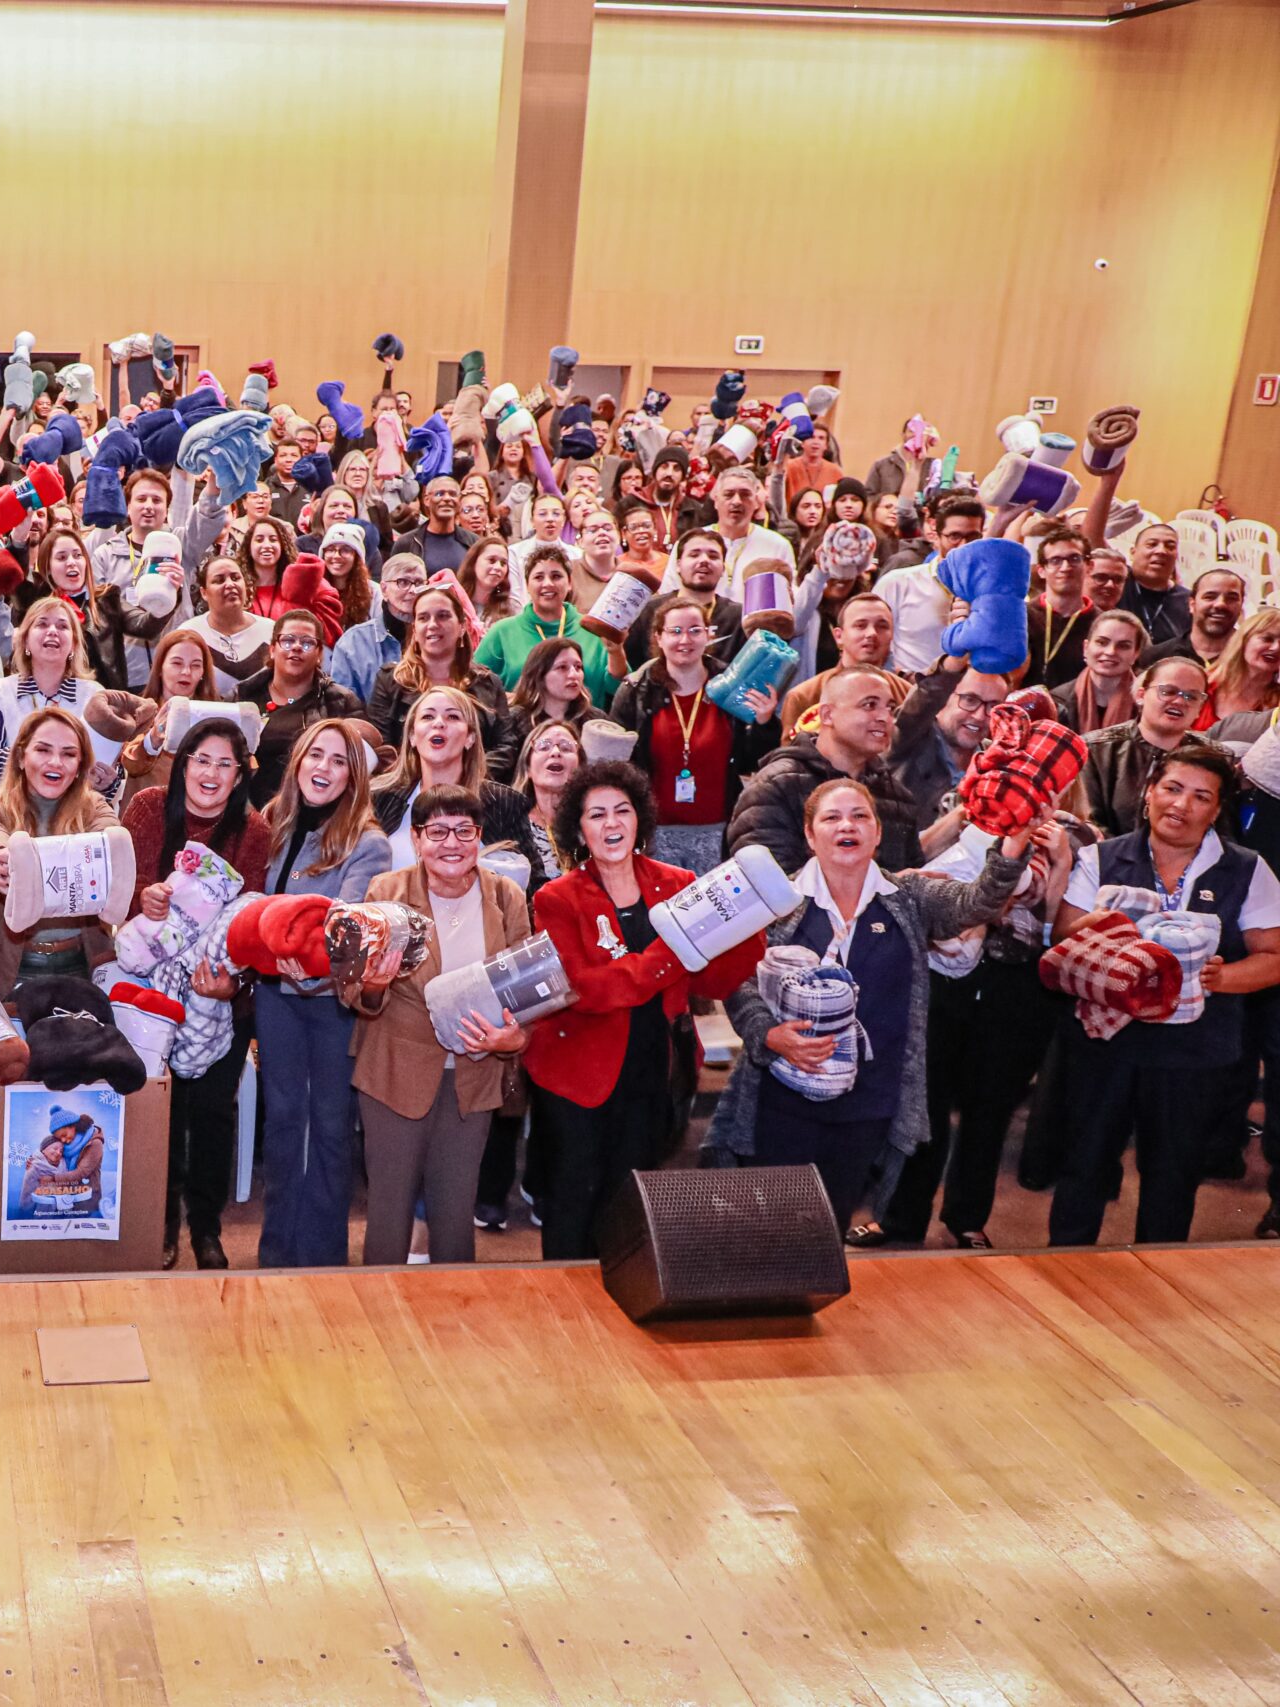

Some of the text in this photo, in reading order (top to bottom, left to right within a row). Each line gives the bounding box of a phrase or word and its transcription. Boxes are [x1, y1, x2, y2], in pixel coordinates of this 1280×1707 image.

[69, 881, 77, 914] MANTA
[705, 886, 732, 922] MANTA
[35, 1186, 90, 1195] AGASALHO
